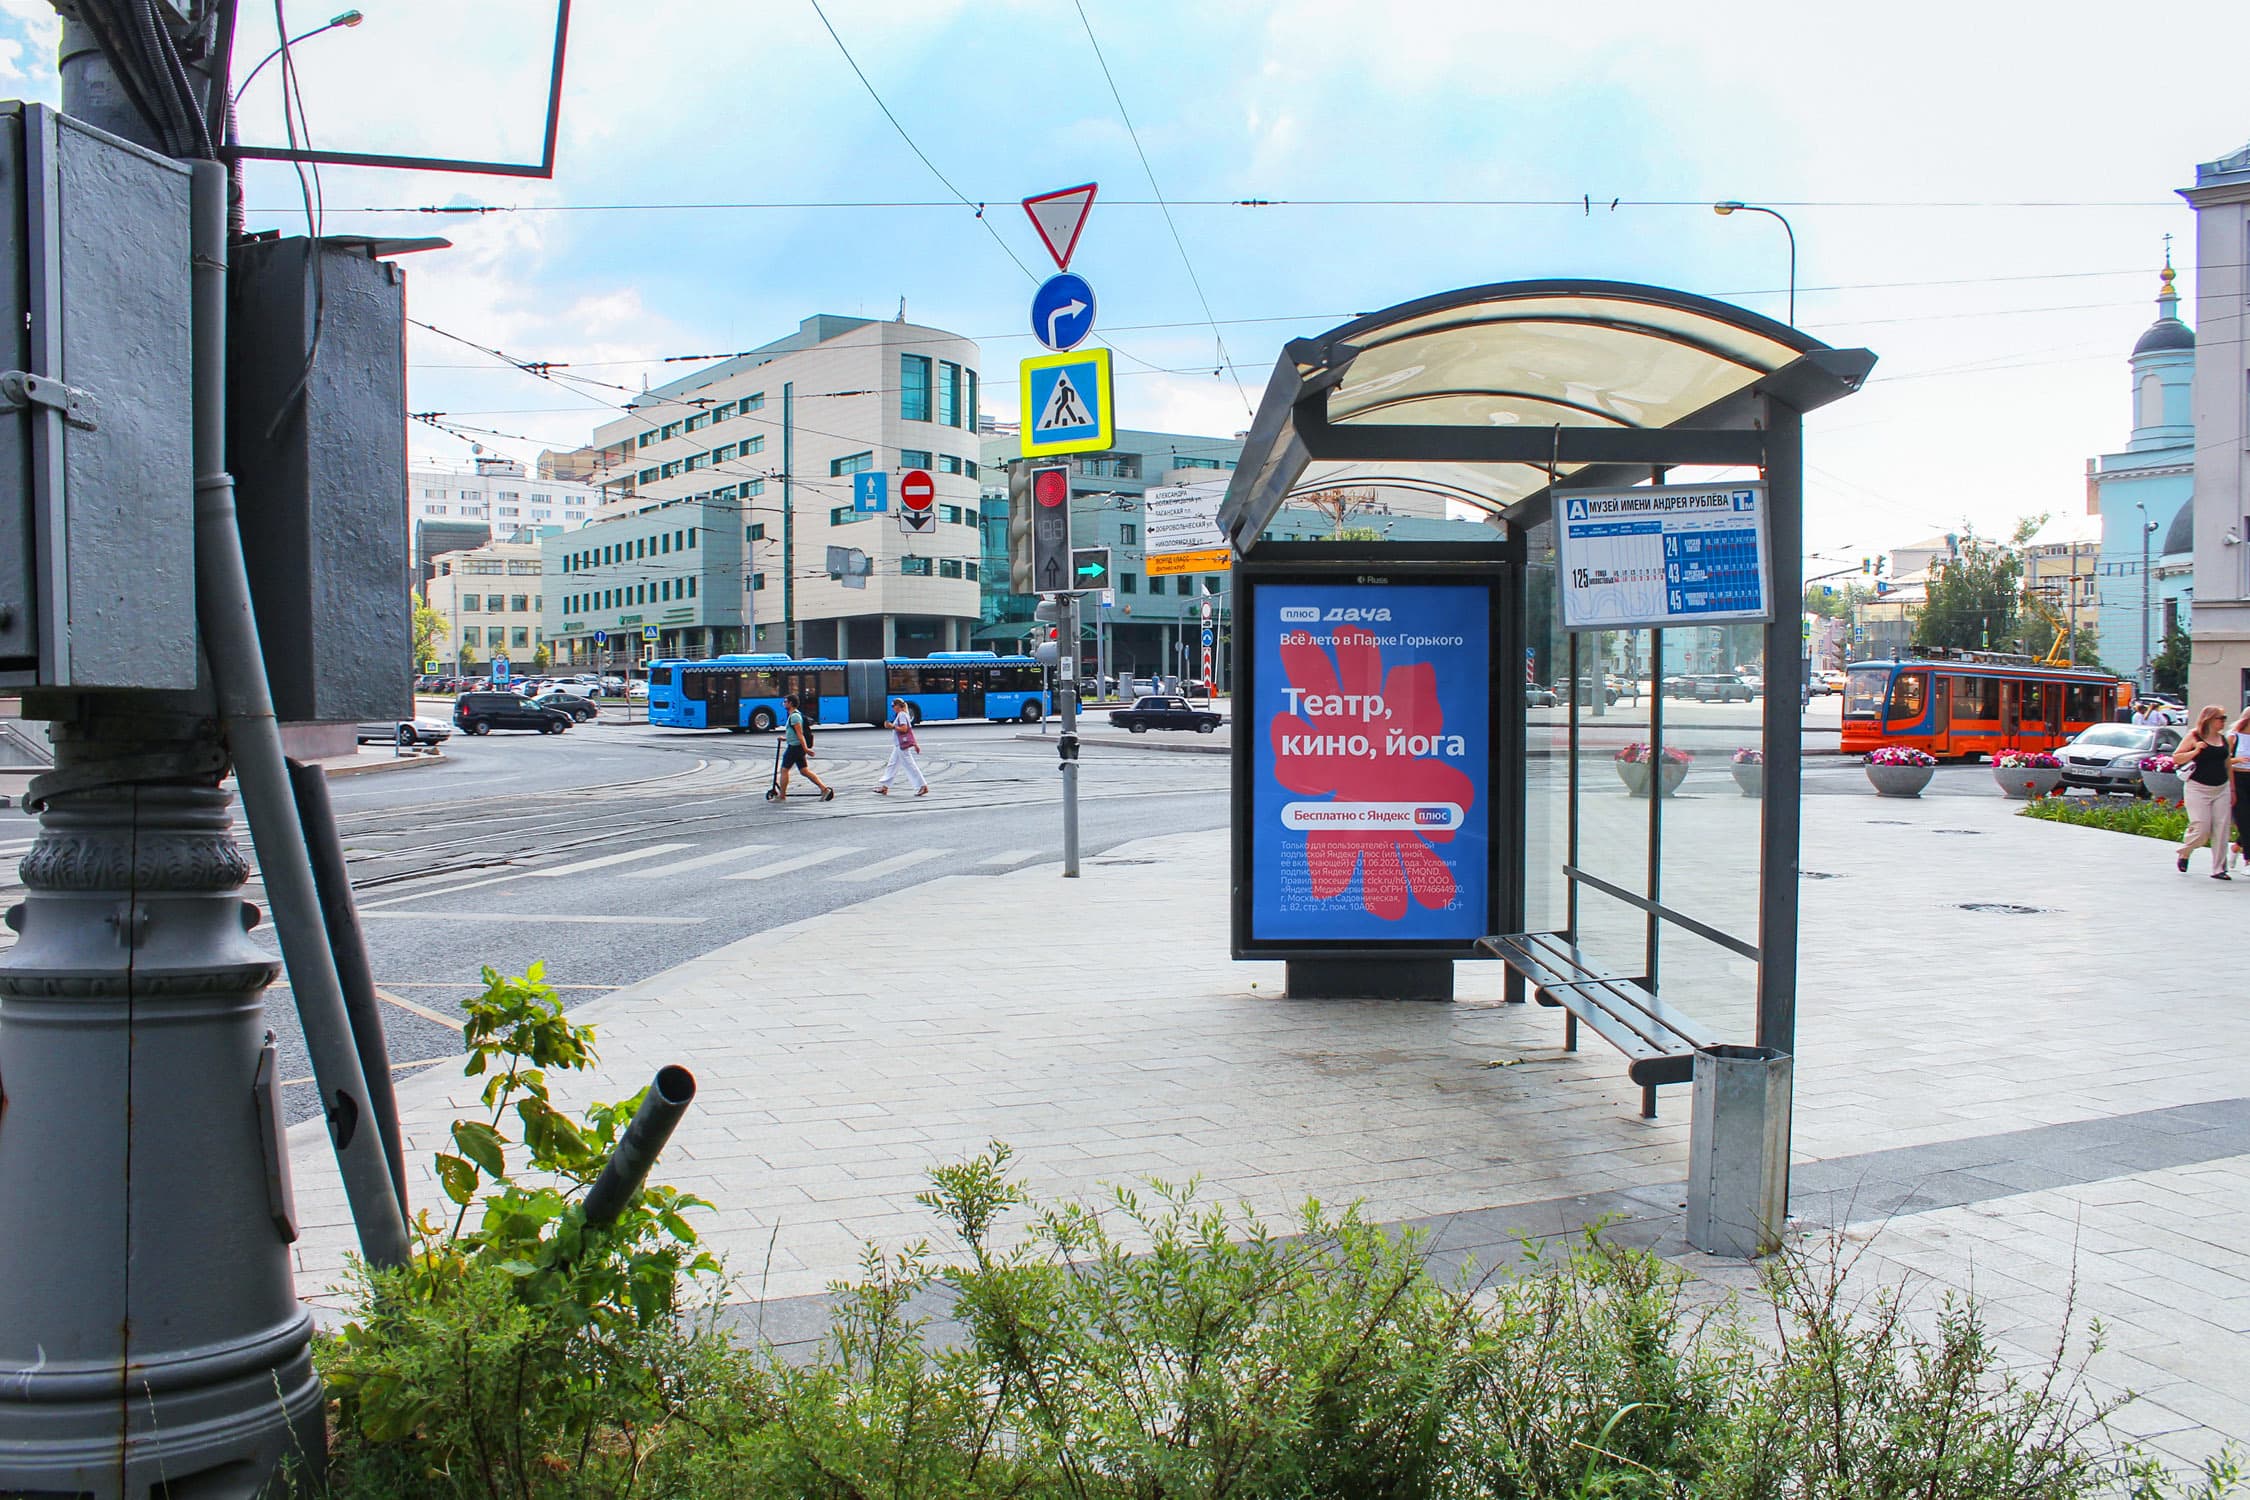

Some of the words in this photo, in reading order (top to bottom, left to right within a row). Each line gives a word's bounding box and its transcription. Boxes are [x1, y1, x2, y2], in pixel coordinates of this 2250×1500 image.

[1589, 498, 1619, 513] МУЗЕЙ
[1620, 499, 1651, 511] ИМЕНИ
[1653, 496, 1687, 511] АНДРЕЯ
[1689, 493, 1729, 508] РУБЛЁВА
[1155, 521, 1206, 533] ДОБРОВОЛЬЧЕСКАЯ
[1666, 536, 1679, 557] 24
[1572, 568, 1589, 589] 125
[1668, 563, 1680, 583] 43
[1670, 590, 1682, 610] 45
[1323, 607, 1392, 622] дача
[1280, 633, 1305, 646] Всё
[1308, 636, 1340, 646] лето
[1343, 636, 1351, 646] в
[1354, 633, 1397, 648] Парке
[1399, 633, 1463, 648] Горького
[1281, 688, 1393, 723] Театр,
[1282, 734, 1377, 761] кино,
[1386, 727, 1465, 756] йога
[1294, 810, 1357, 822] Бесплатно
[1358, 812, 1366, 822] с
[1368, 810, 1411, 823] Яндекс
[1280, 840, 1309, 850] Только
[1310, 842, 1325, 851] для
[1327, 840, 1389, 850] пользователей
[1396, 839, 1435, 849] активной
[1280, 850, 1325, 859] подпиской
[1327, 850, 1356, 860] Яндекс
[1357, 849, 1380, 858] Плюс
[1292, 858, 1349, 869] включающей)
[1356, 858, 1399, 867] 01.06.2022
[1423, 858, 1457, 867] Условия
[1280, 867, 1321, 877] подписки
[1322, 867, 1352, 877] Яндекс
[1280, 876, 1317, 885] Правила
[1428, 876, 1450, 885] ООО
[1380, 885, 1403, 894] ОГРН
[1442, 898, 1464, 912] 16+
